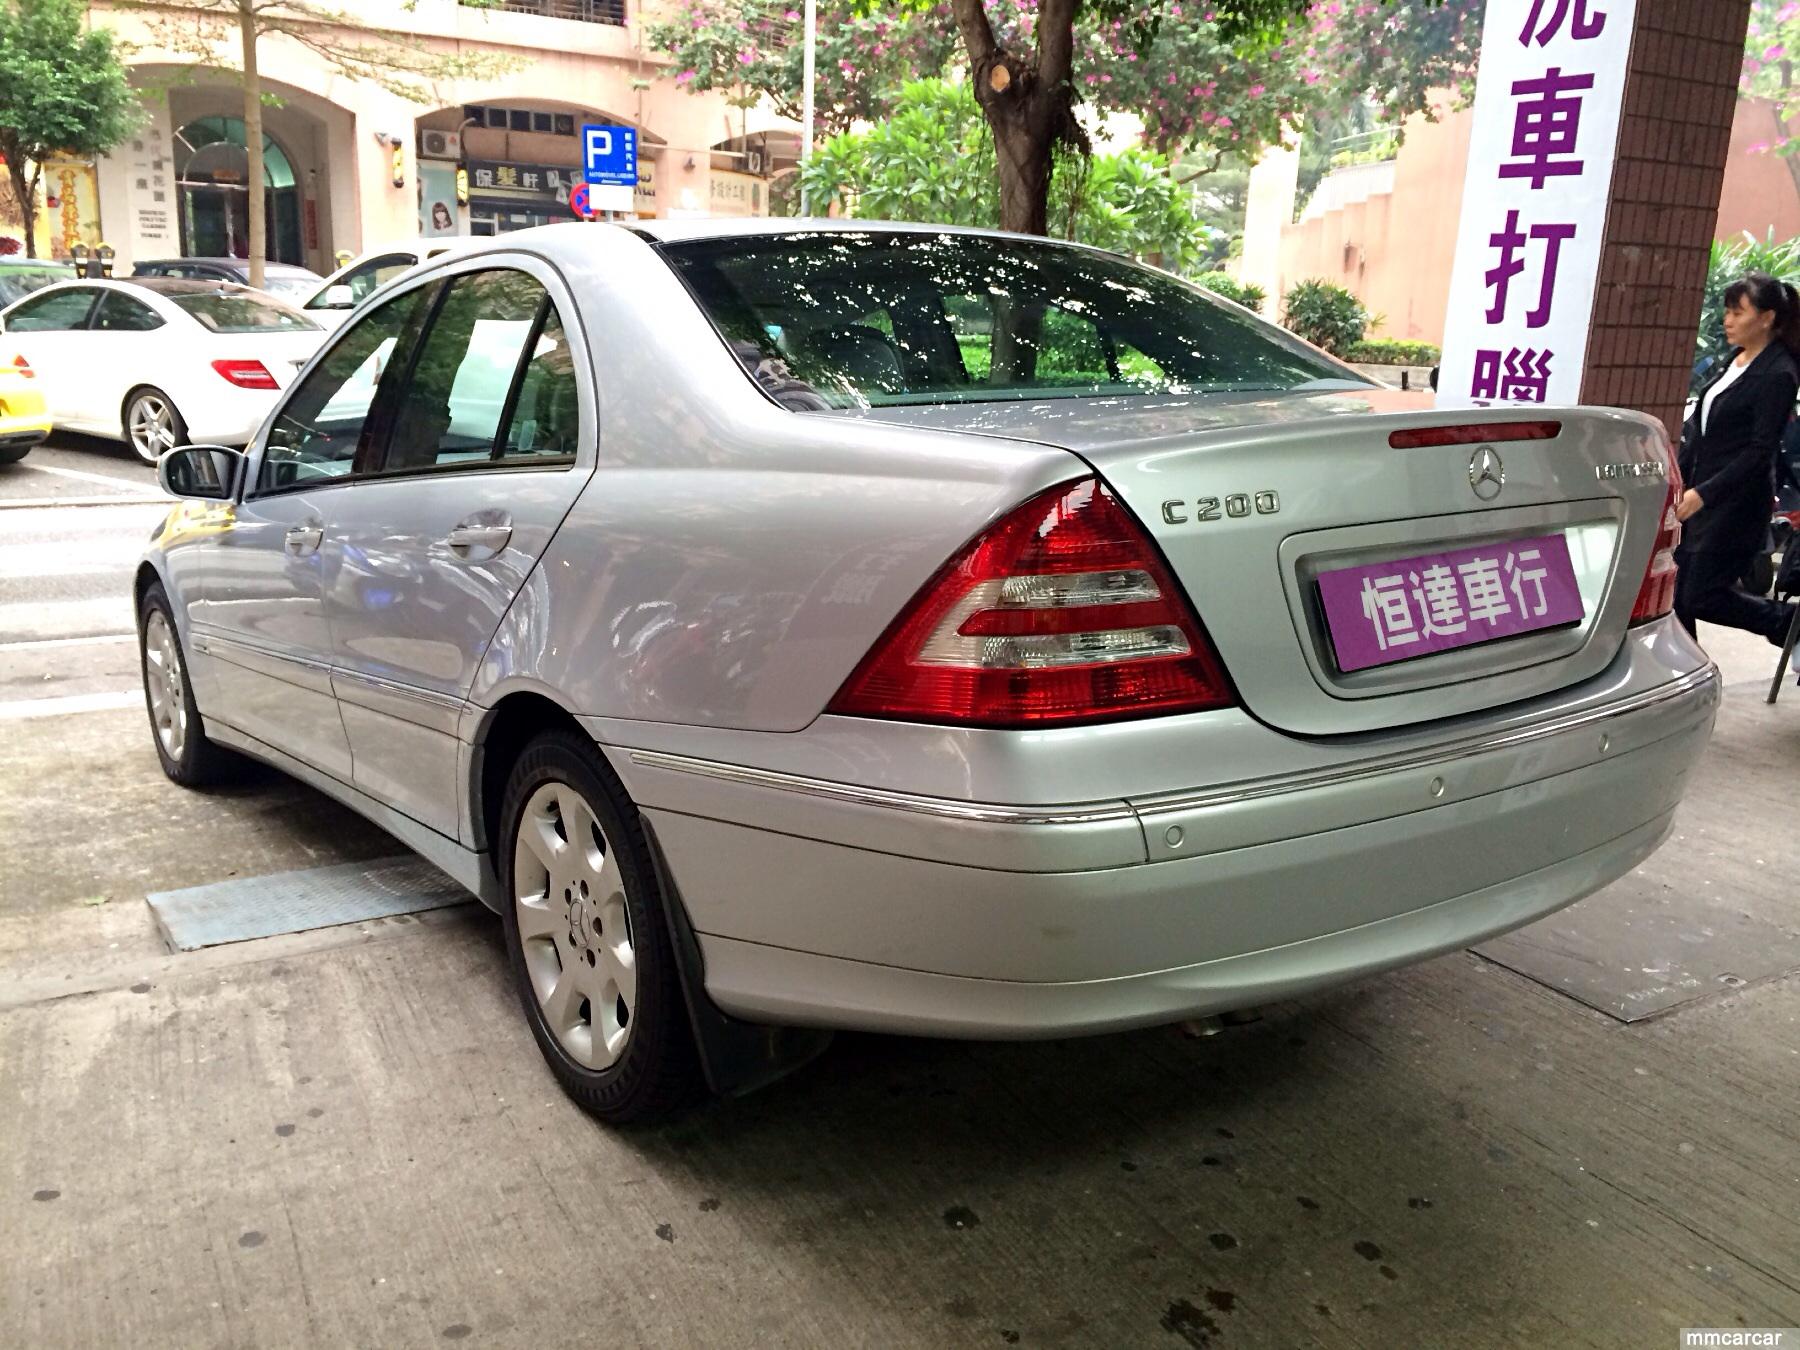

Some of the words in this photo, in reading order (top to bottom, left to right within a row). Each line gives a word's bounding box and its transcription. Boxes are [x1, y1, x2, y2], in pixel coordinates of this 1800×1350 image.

[587, 130, 612, 169] P
[1162, 500, 1188, 524] C
[1197, 490, 1280, 522] 200
[1361, 550, 1548, 650] 恒達車行
